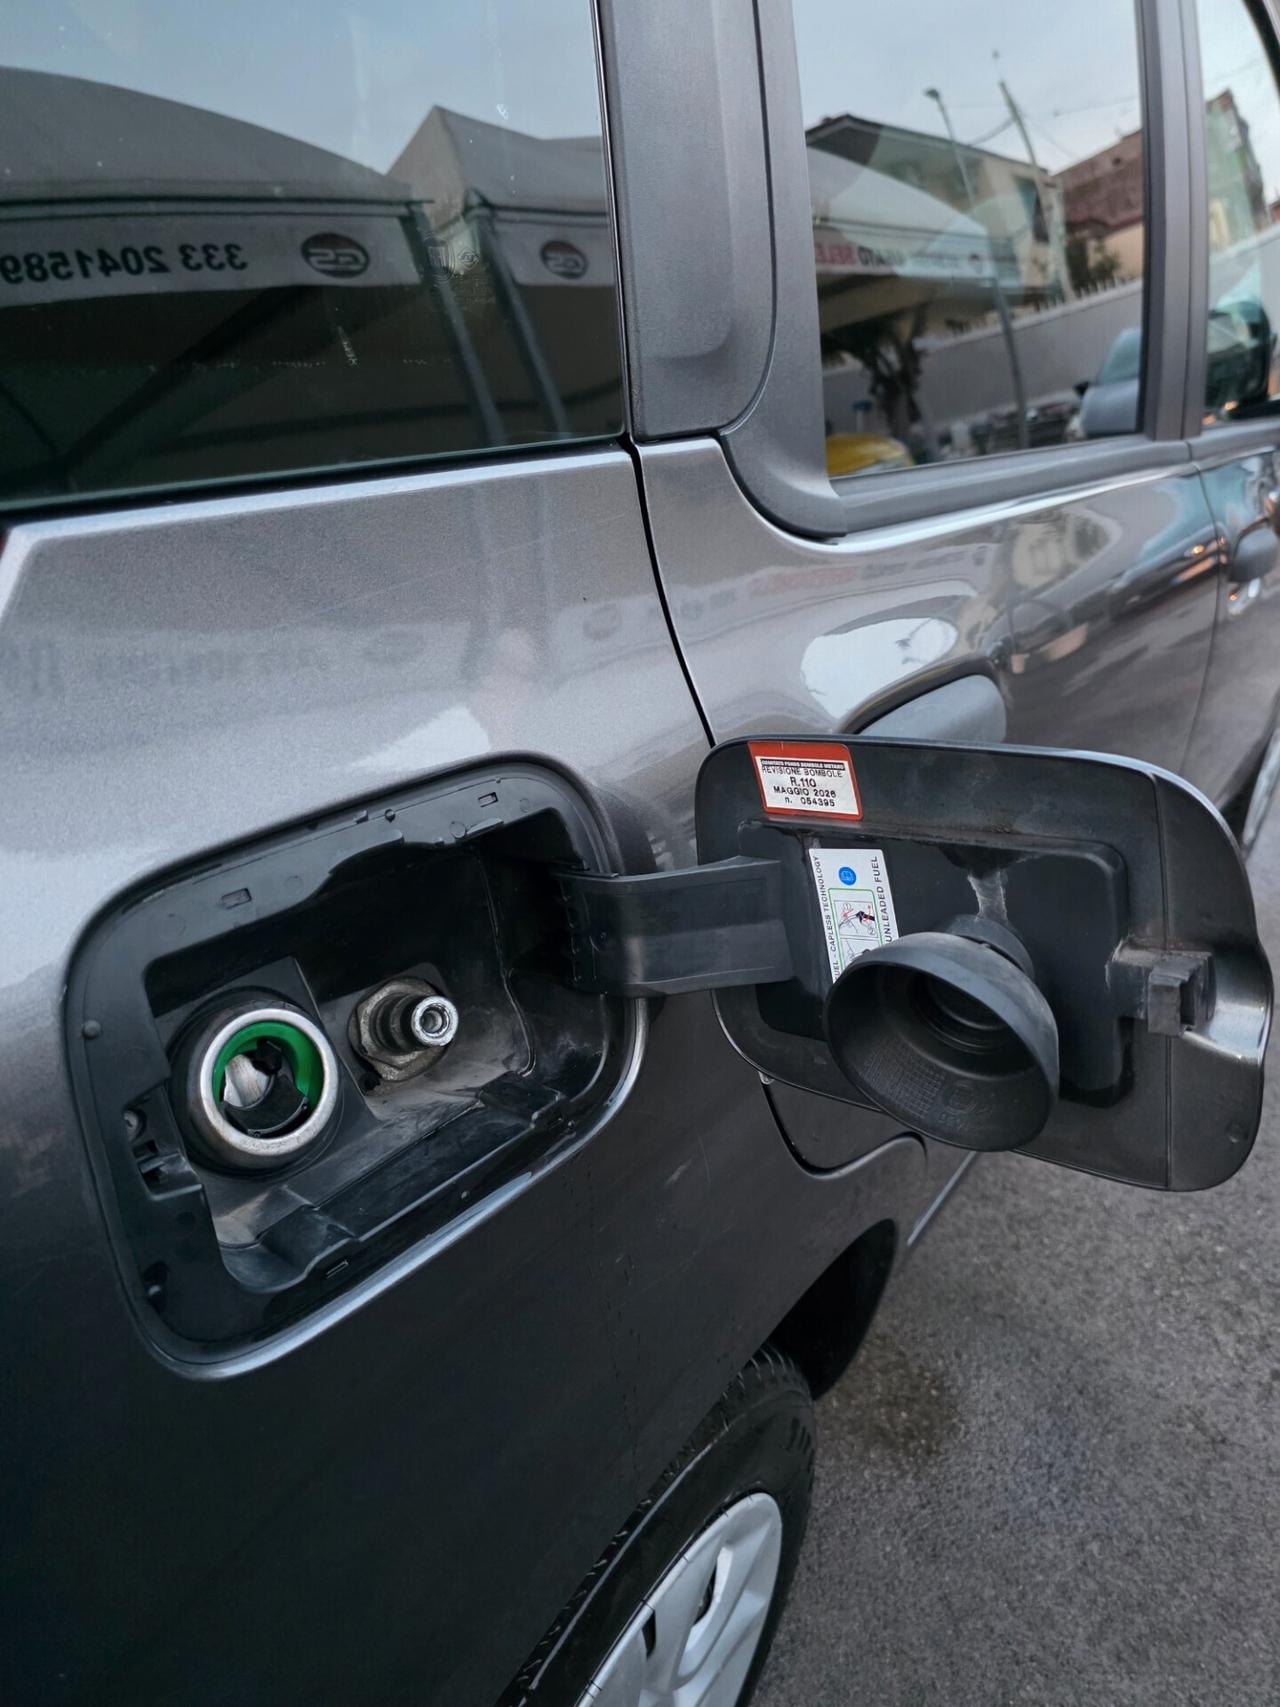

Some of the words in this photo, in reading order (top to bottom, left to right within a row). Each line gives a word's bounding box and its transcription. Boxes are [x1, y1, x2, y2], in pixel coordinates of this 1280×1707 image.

[762, 766, 802, 776] REVISIONE
[804, 768, 843, 778] BOMBOLE
[789, 776, 817, 788] R.110
[773, 785, 809, 796] MAGGIO
[870, 856, 882, 883] FUEL
[812, 855, 829, 912] TECHNOLOGY
[875, 886, 893, 942] UNLEADED
[825, 914, 836, 952] CAPLESS
